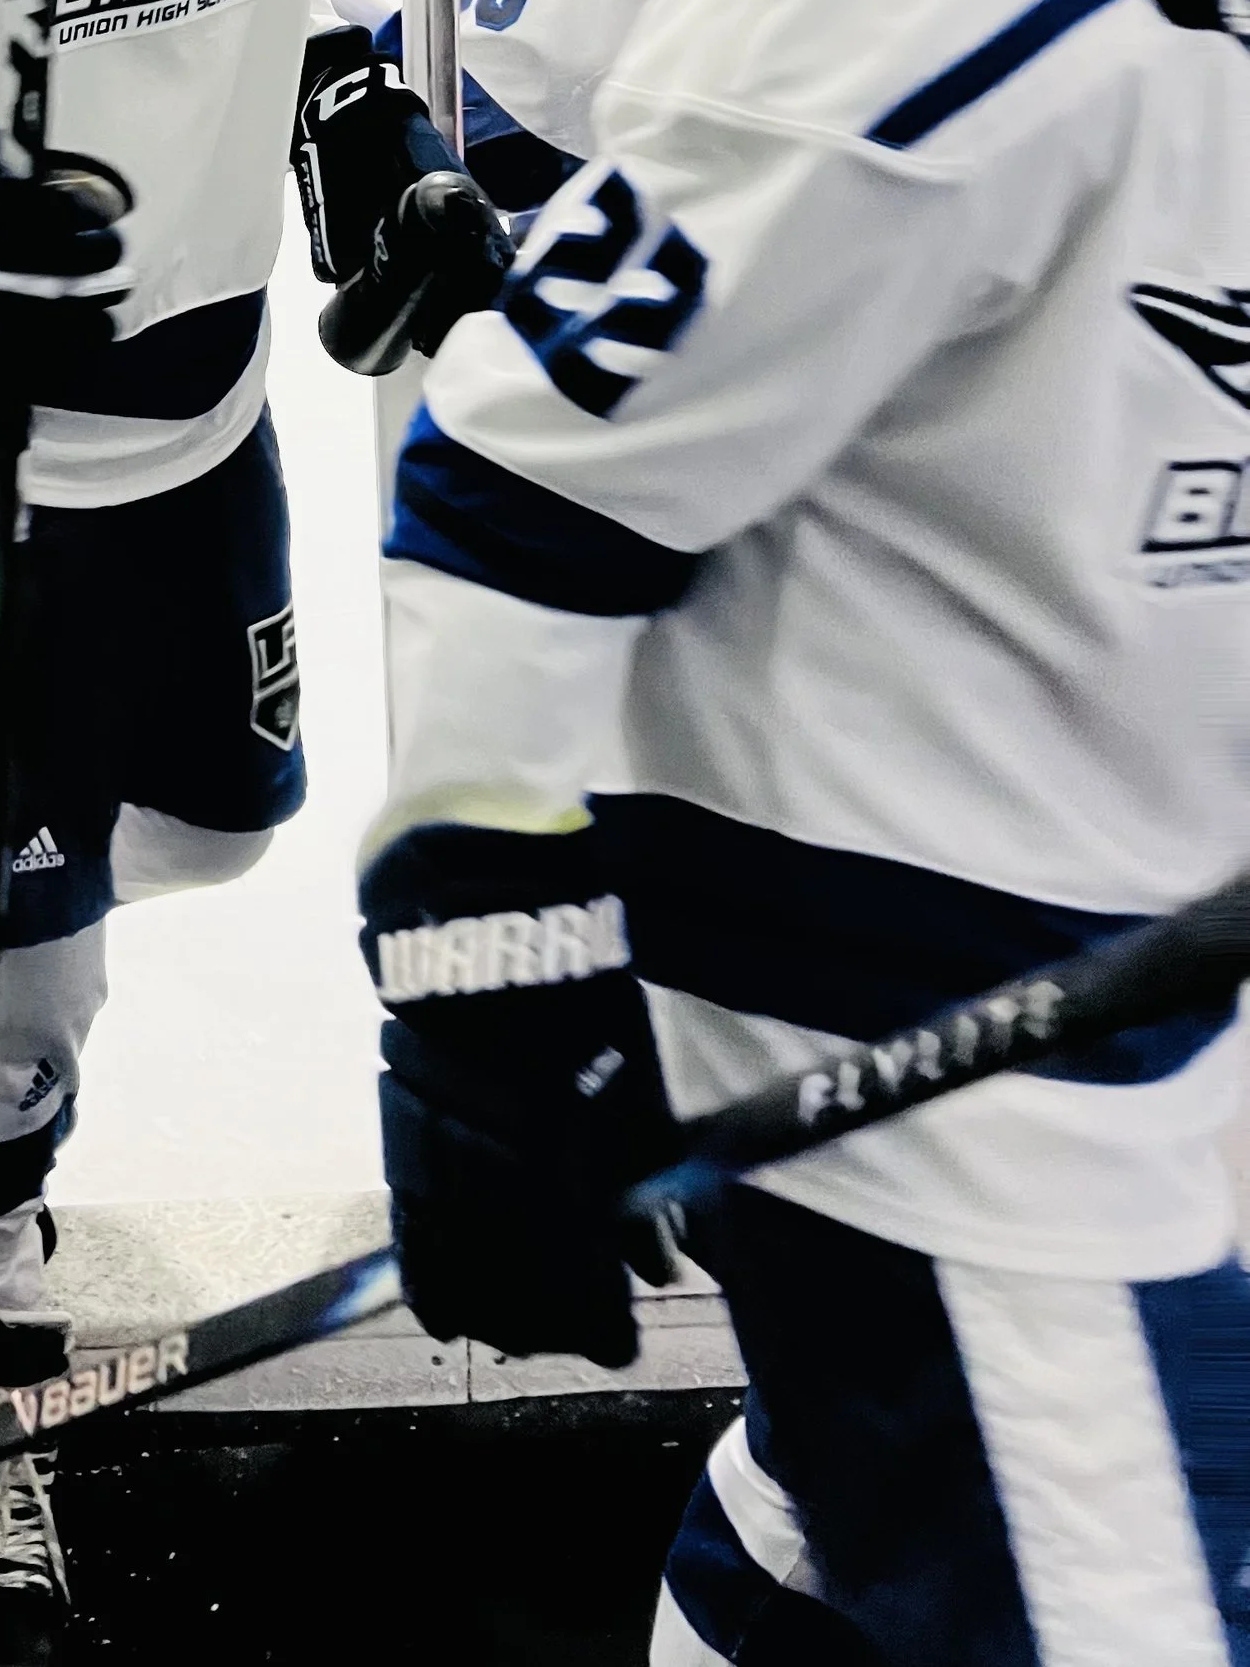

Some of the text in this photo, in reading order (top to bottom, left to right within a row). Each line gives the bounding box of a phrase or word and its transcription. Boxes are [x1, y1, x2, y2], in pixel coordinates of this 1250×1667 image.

[58, 13, 129, 45] UNION
[502, 166, 709, 421] 22
[12, 852, 65, 873] adidas
[39, 1333, 190, 1429] BAUER
